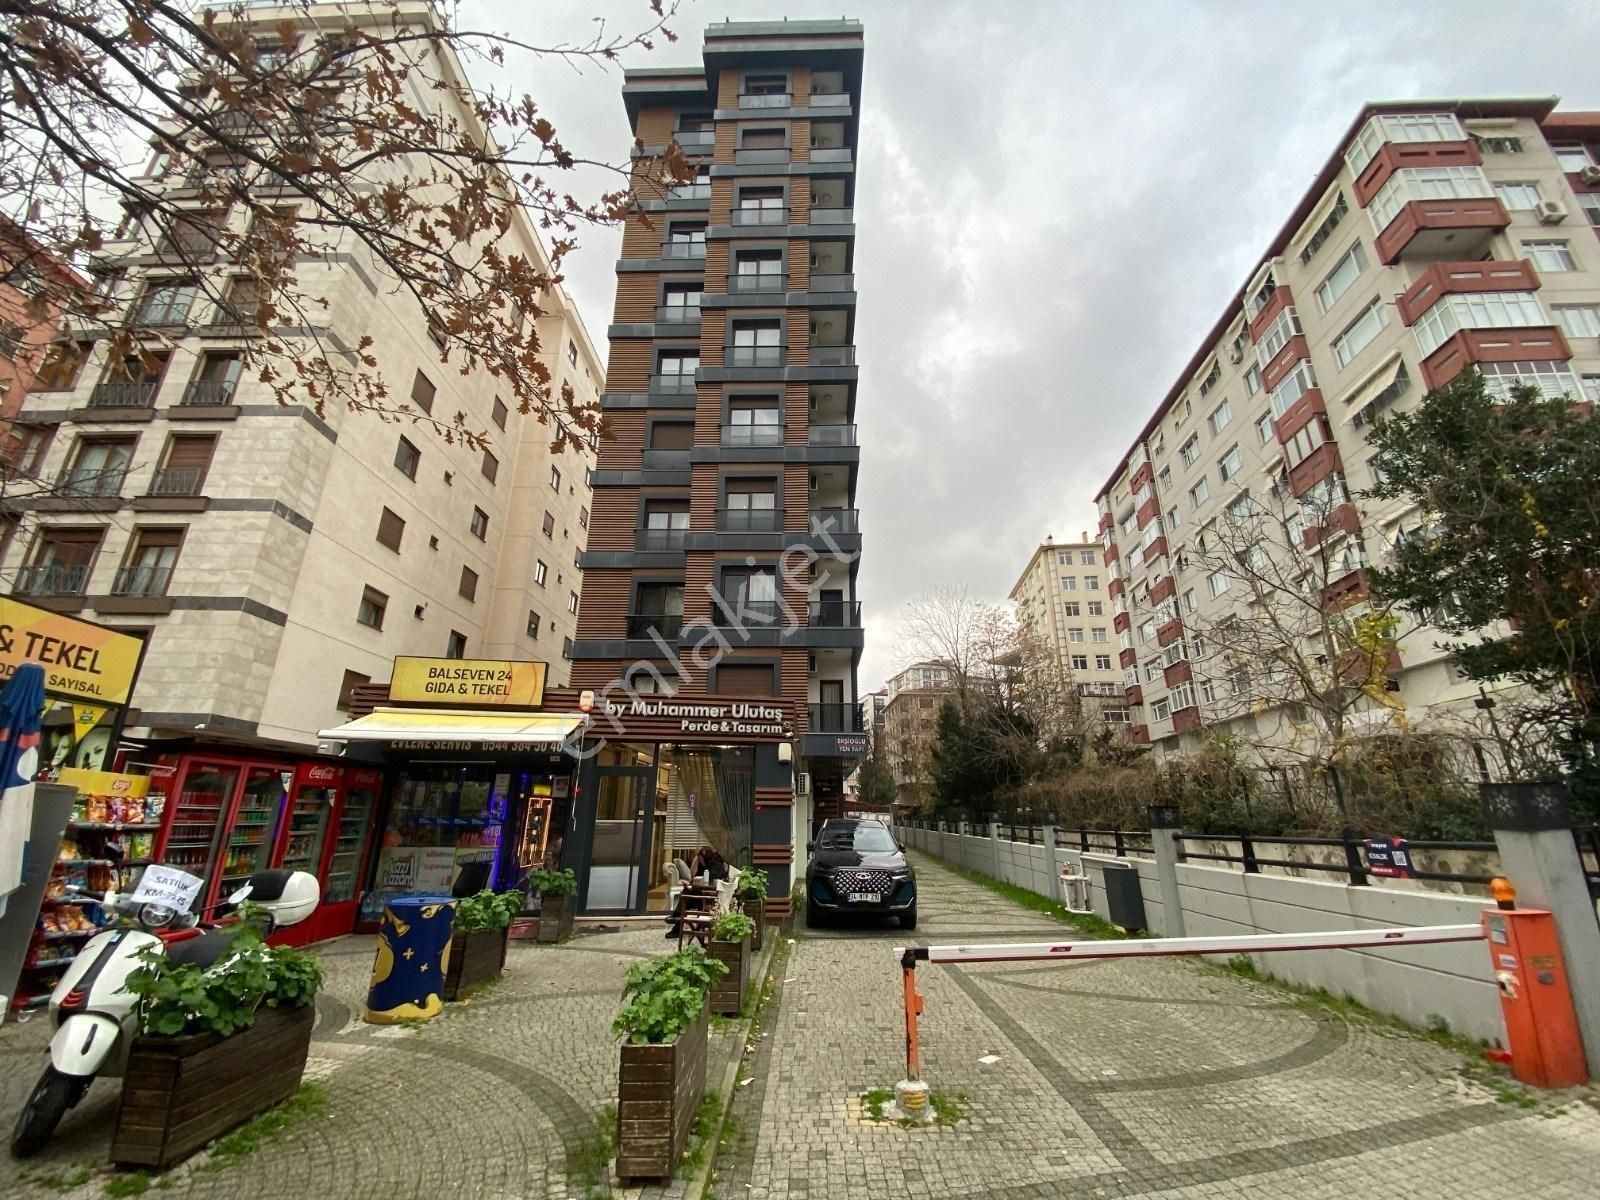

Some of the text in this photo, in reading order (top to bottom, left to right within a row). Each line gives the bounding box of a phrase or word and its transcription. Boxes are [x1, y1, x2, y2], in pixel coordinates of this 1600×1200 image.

[25, 631, 102, 675] TEKEL
[428, 667, 513, 681] BALSEVEN 24
[48, 674, 103, 695] SAYISAL
[425, 682, 511, 696] GIDA & TEKEL
[605, 700, 783, 722] by Muhammer Ulutaş
[680, 719, 719, 732] Perde
